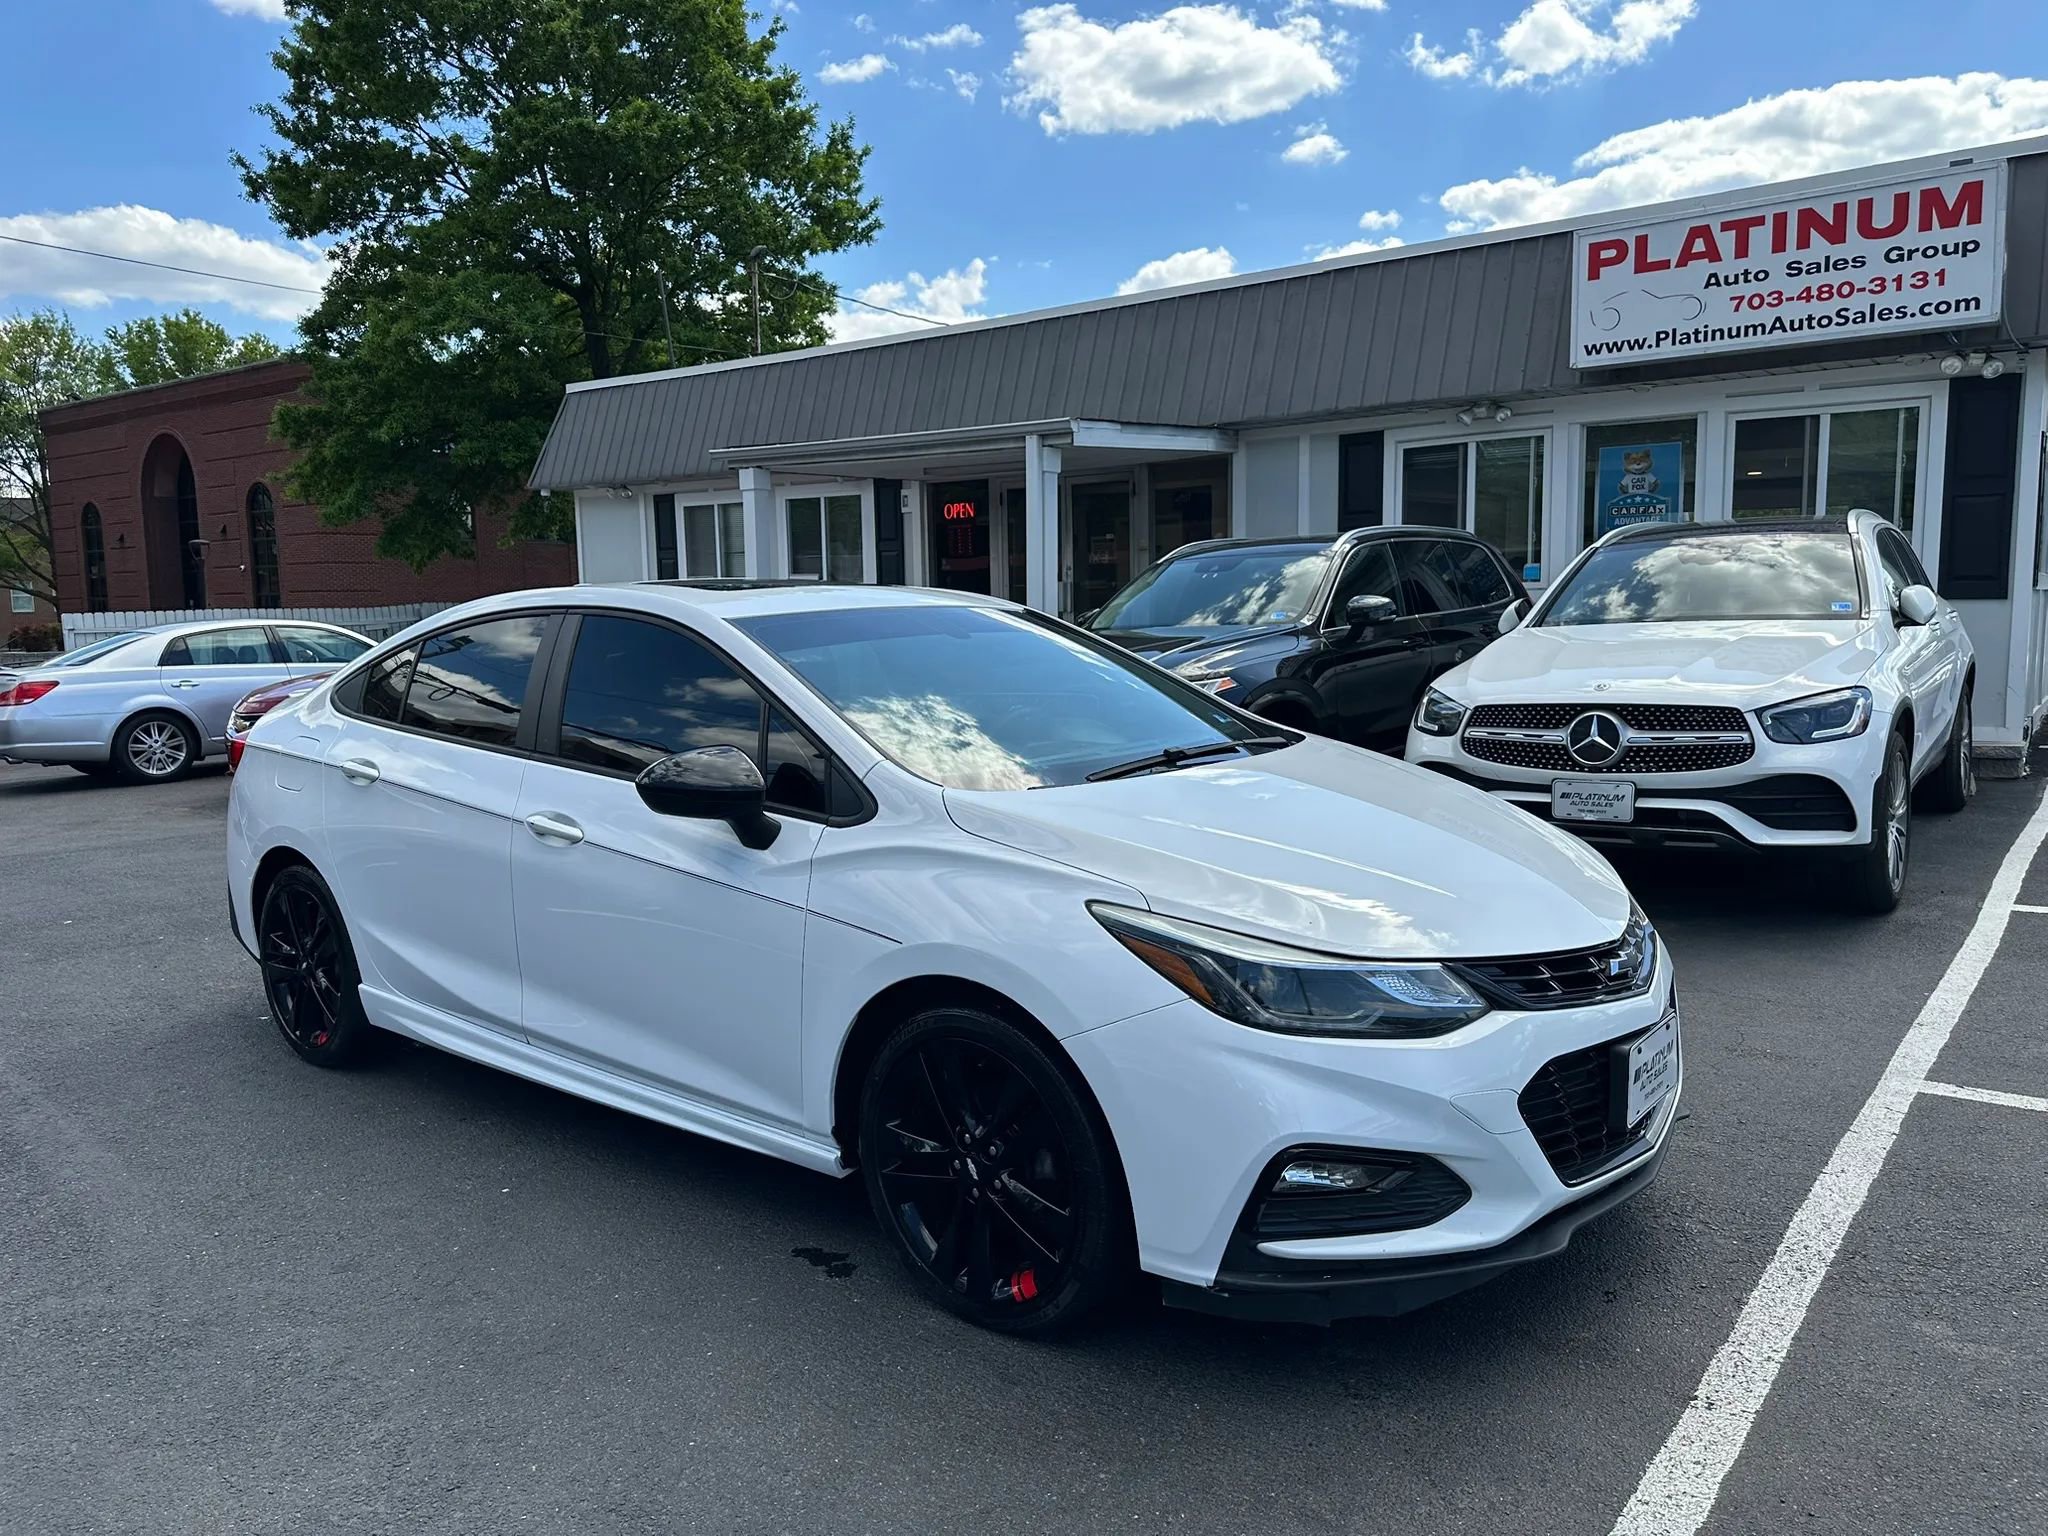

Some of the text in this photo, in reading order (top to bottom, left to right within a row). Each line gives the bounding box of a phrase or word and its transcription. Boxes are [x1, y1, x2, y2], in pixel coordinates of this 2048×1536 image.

[1588, 180, 1984, 281] PLATINUM
[1703, 239, 1980, 289] Auto Sales Group
[1729, 268, 1947, 313] 703-480-3131
[1583, 295, 1981, 357] www.PlatinumAutoSales.com
[944, 502, 975, 519] OPEN
[1611, 505, 1665, 515] CARFAX
[1571, 793, 1626, 802] PLATINUM
